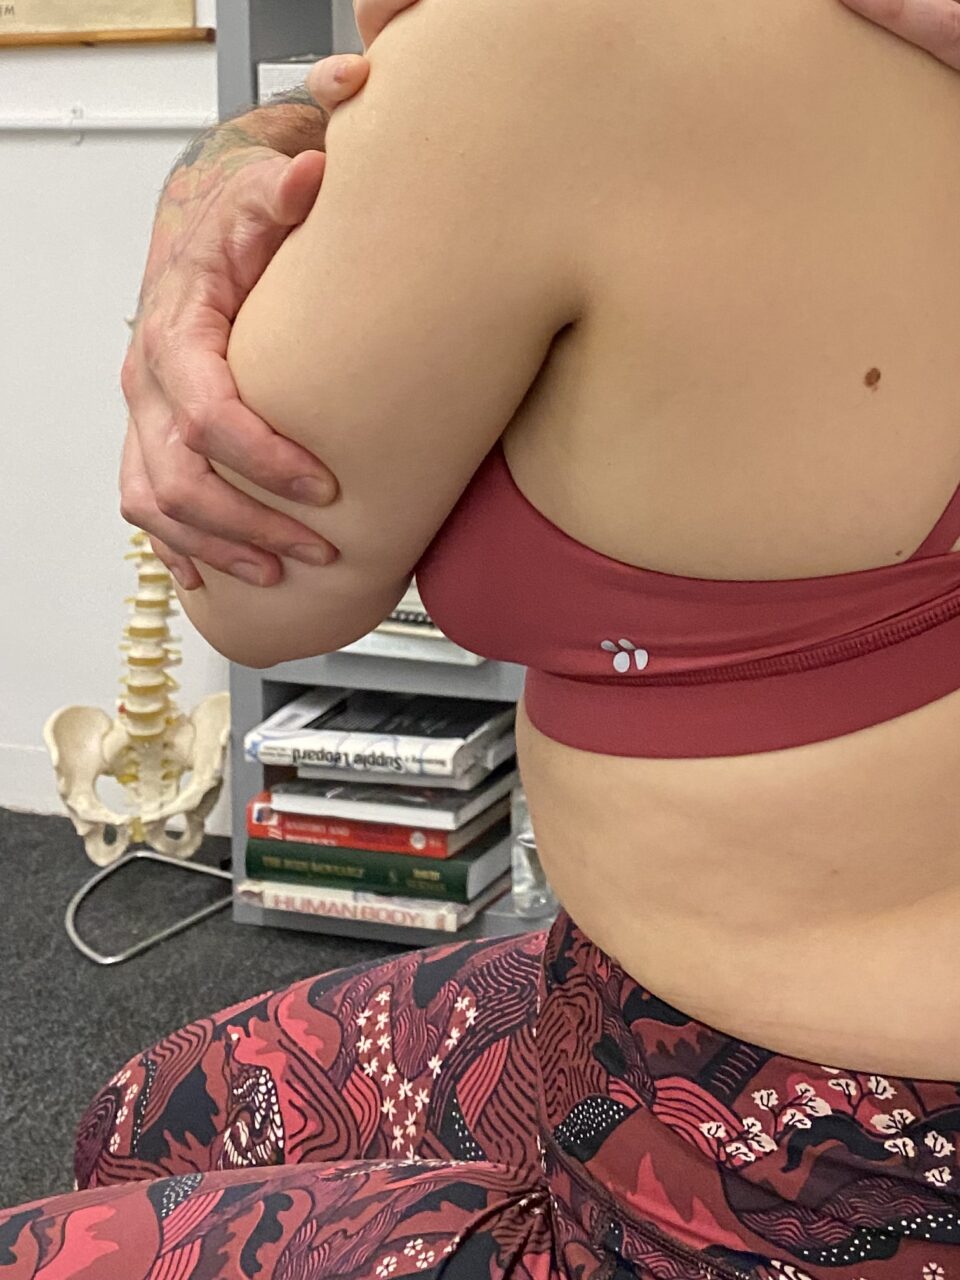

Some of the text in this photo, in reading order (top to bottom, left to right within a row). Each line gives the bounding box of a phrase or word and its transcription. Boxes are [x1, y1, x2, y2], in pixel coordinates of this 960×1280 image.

[292, 747, 351, 767] Leopard
[353, 751, 403, 771] Supple
[273, 894, 359, 920] HUMAN
[361, 904, 420, 926] BODY
